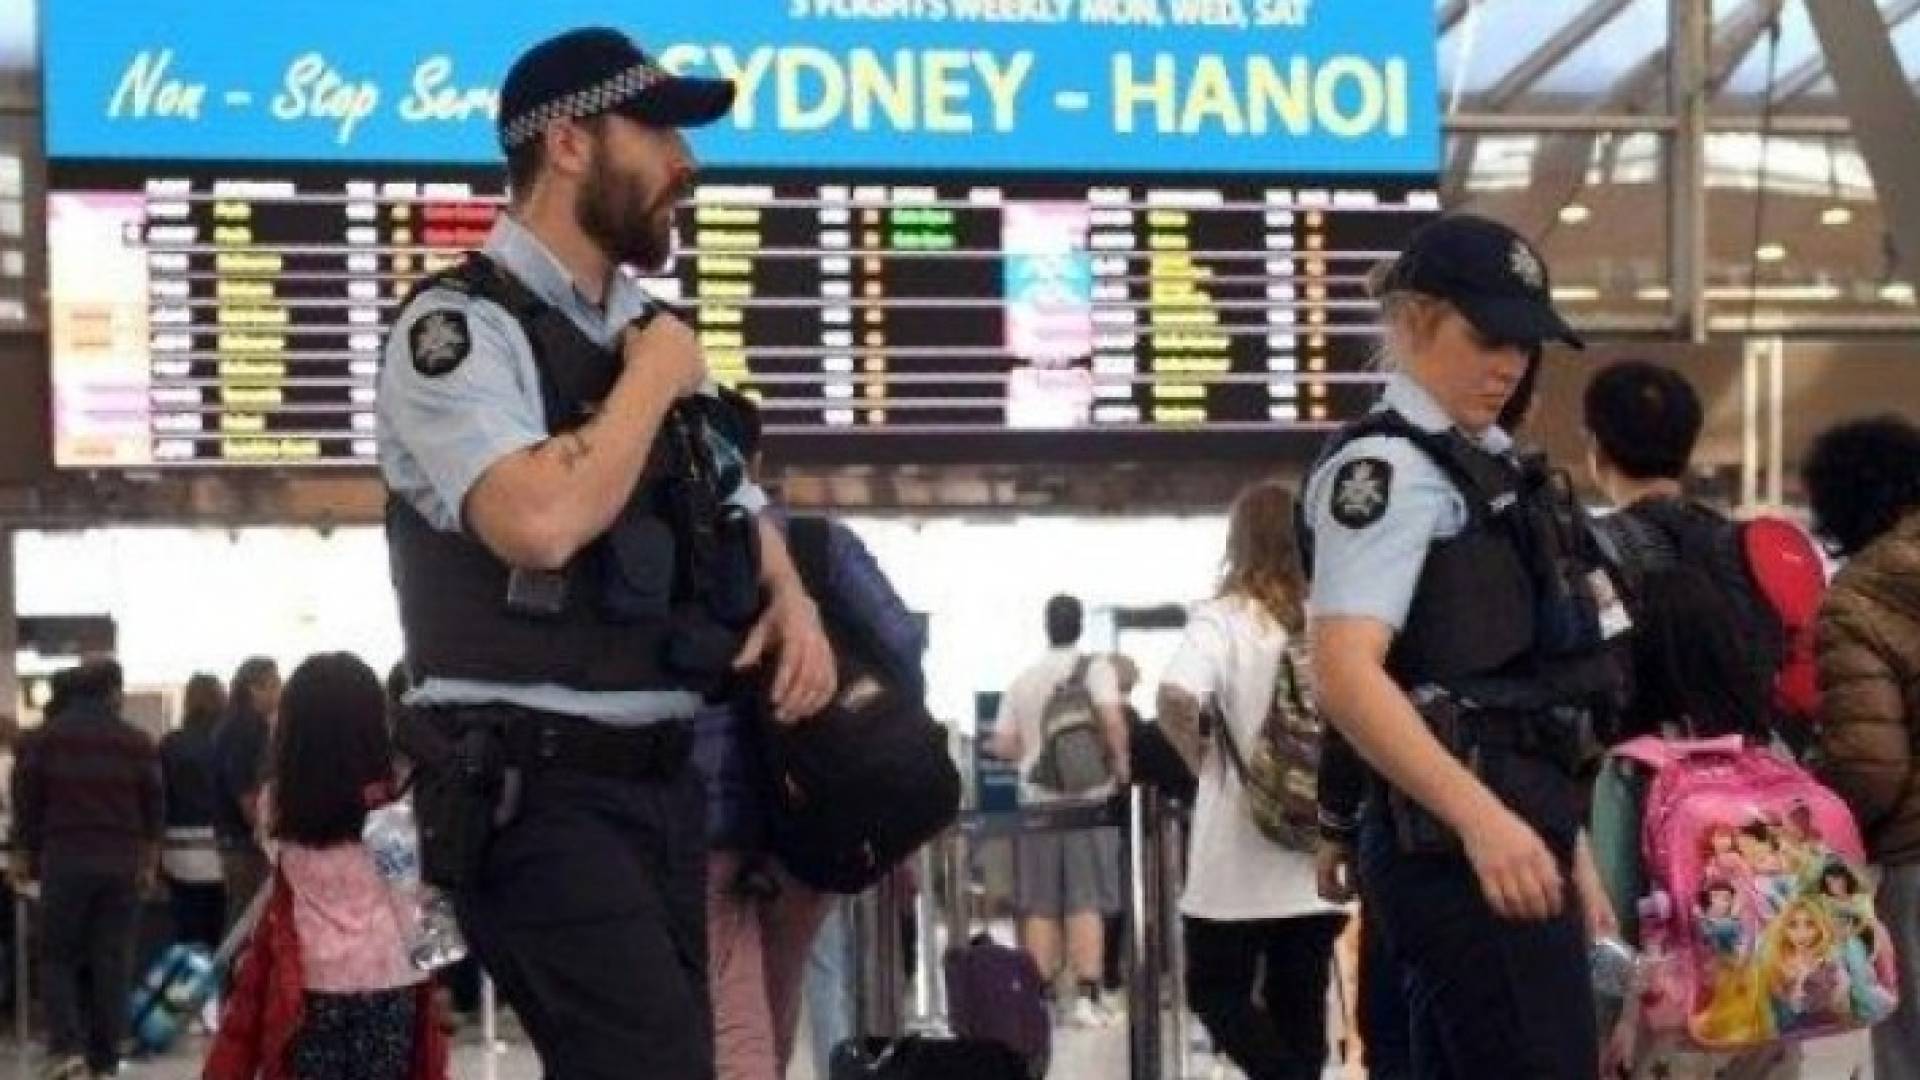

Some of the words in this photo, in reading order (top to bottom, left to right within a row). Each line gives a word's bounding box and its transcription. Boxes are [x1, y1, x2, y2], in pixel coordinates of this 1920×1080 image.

[951, 0, 1072, 23] WEEKLY
[1253, 0, 1308, 26] SAT
[107, 49, 204, 118] Non
[273, 52, 378, 143] Stop
[1055, 91, 1089, 110] -
[1113, 53, 1407, 135] HANOI
